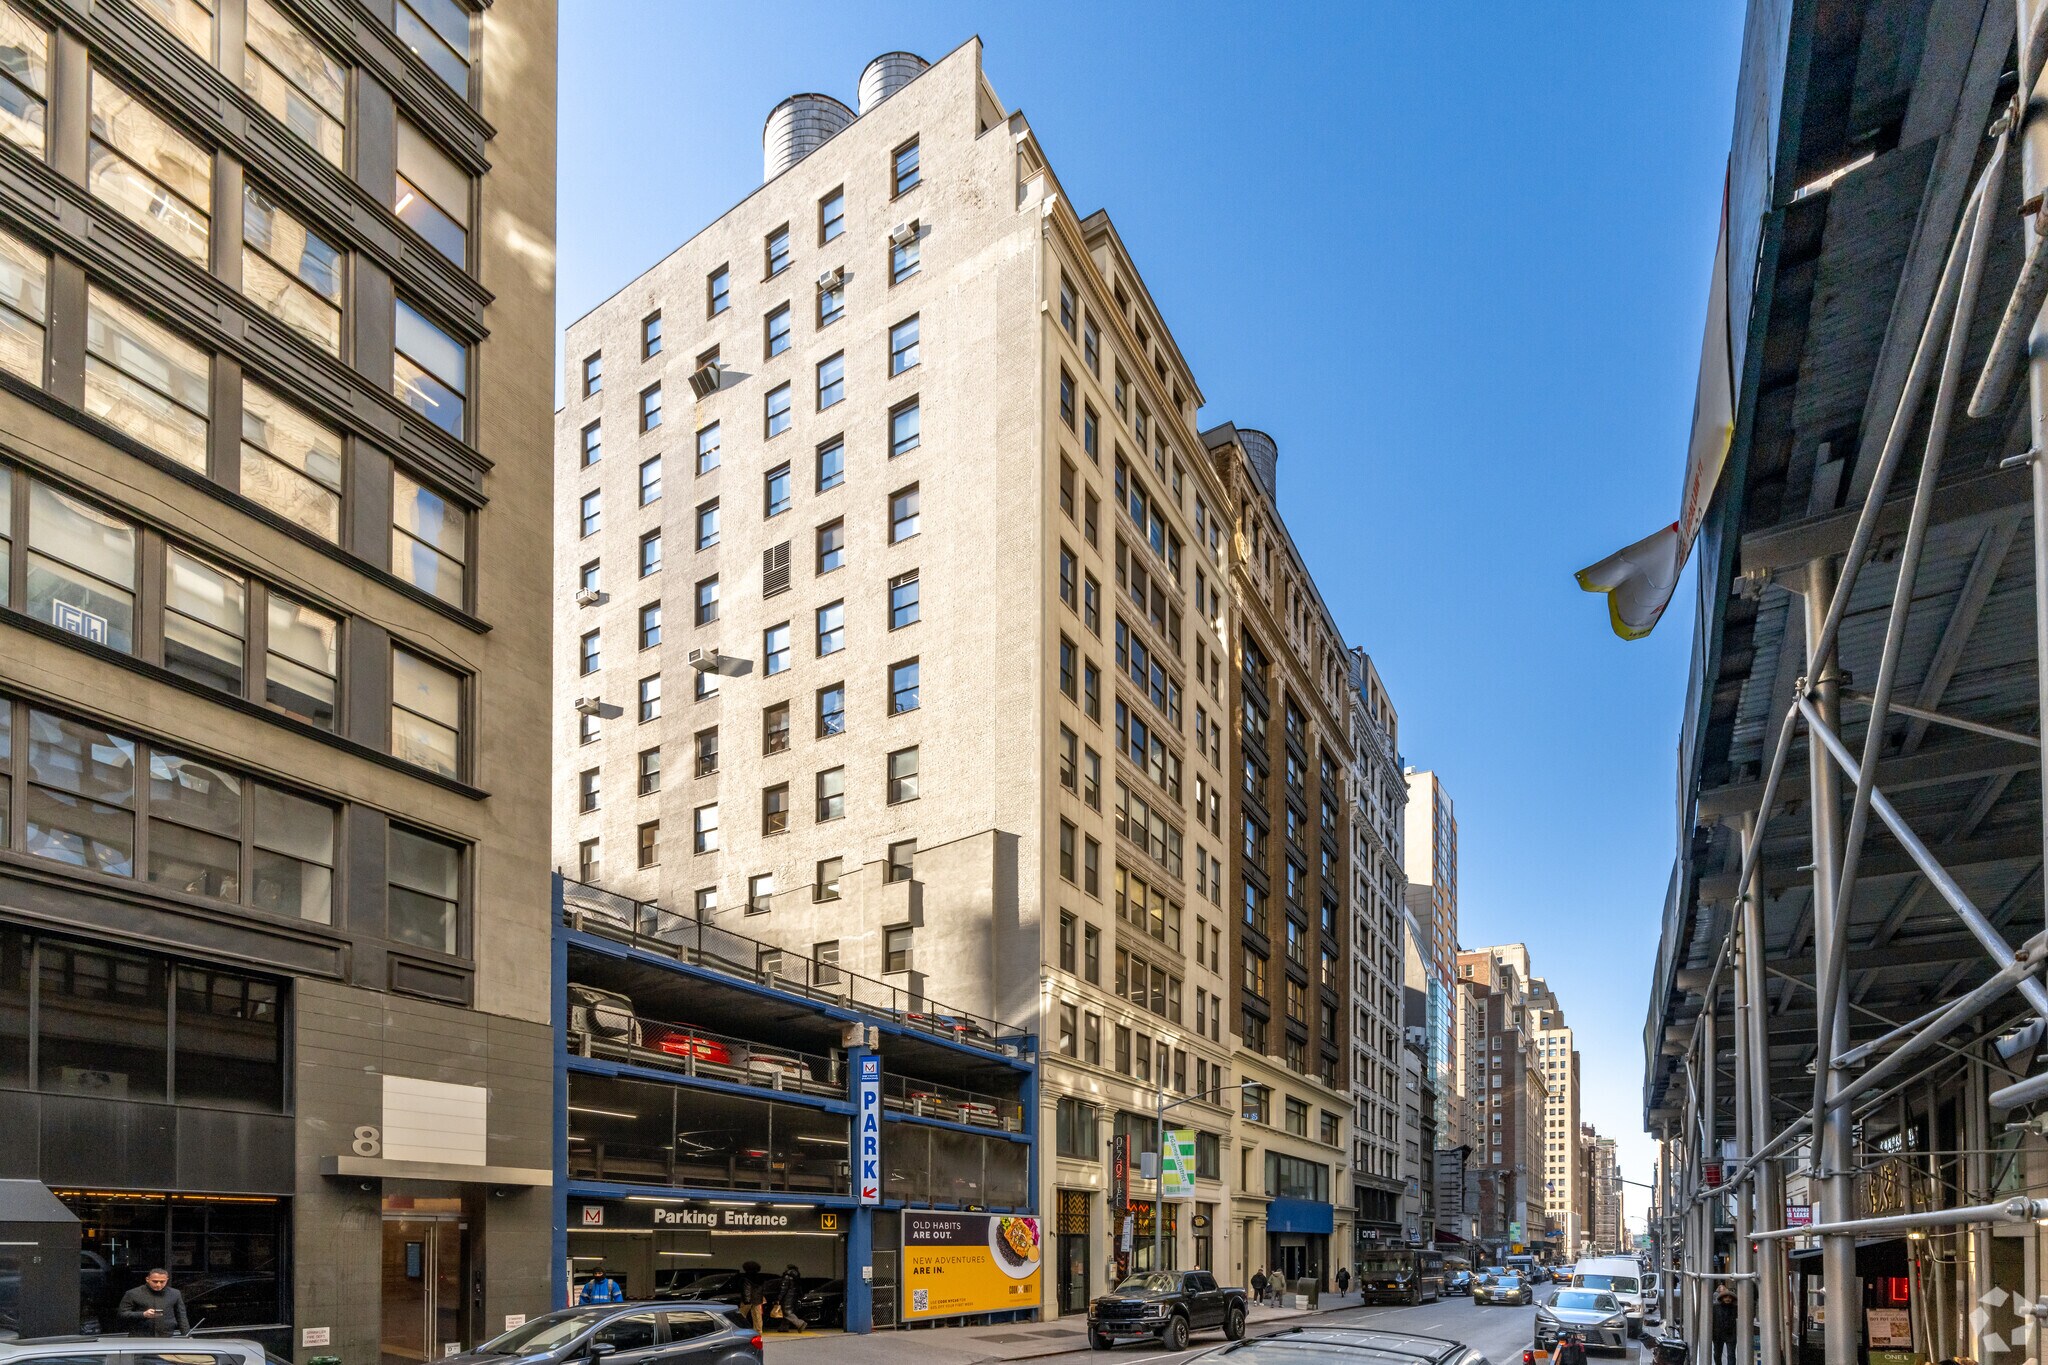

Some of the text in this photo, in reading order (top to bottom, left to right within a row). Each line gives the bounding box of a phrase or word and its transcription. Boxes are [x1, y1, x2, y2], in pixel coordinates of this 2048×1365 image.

[352, 1126, 380, 1157] 8
[863, 1091, 878, 1179] PARK
[1115, 1136, 1123, 1207] CLINTON HALL
[654, 1208, 788, 1227] Parking Entrance
[912, 1221, 961, 1230] OLD HABITS
[912, 1231, 952, 1239] ARE OUT.
[912, 1256, 985, 1265] NEW ADVENTURES
[913, 1266, 945, 1275] ARE IN.
